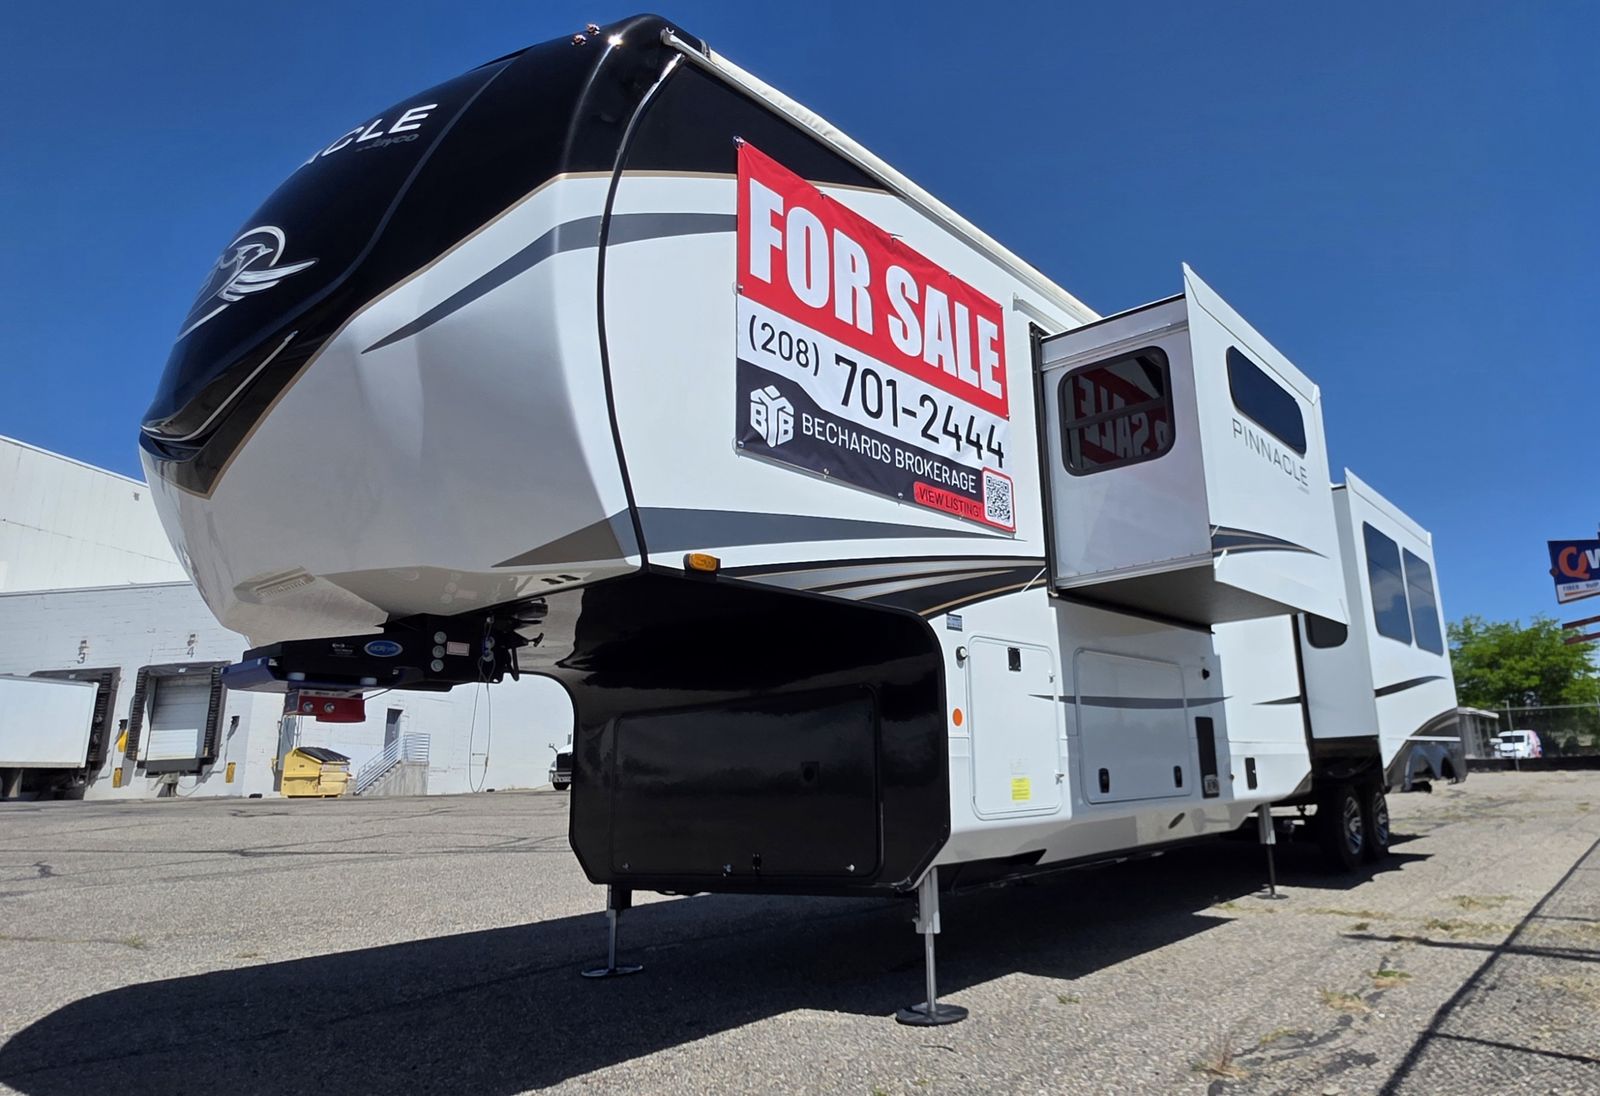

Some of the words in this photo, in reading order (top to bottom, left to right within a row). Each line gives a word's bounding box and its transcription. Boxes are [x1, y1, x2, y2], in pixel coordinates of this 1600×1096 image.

[750, 178, 873, 335] FOR
[886, 265, 1002, 399] SALE
[749, 314, 820, 376] (208)
[834, 353, 1004, 468] 701-2444
[803, 412, 891, 463] BECHARDS
[895, 449, 977, 494] BROKERAGE
[1232, 417, 1308, 487] PINNACLE
[919, 487, 944, 506] VIEW
